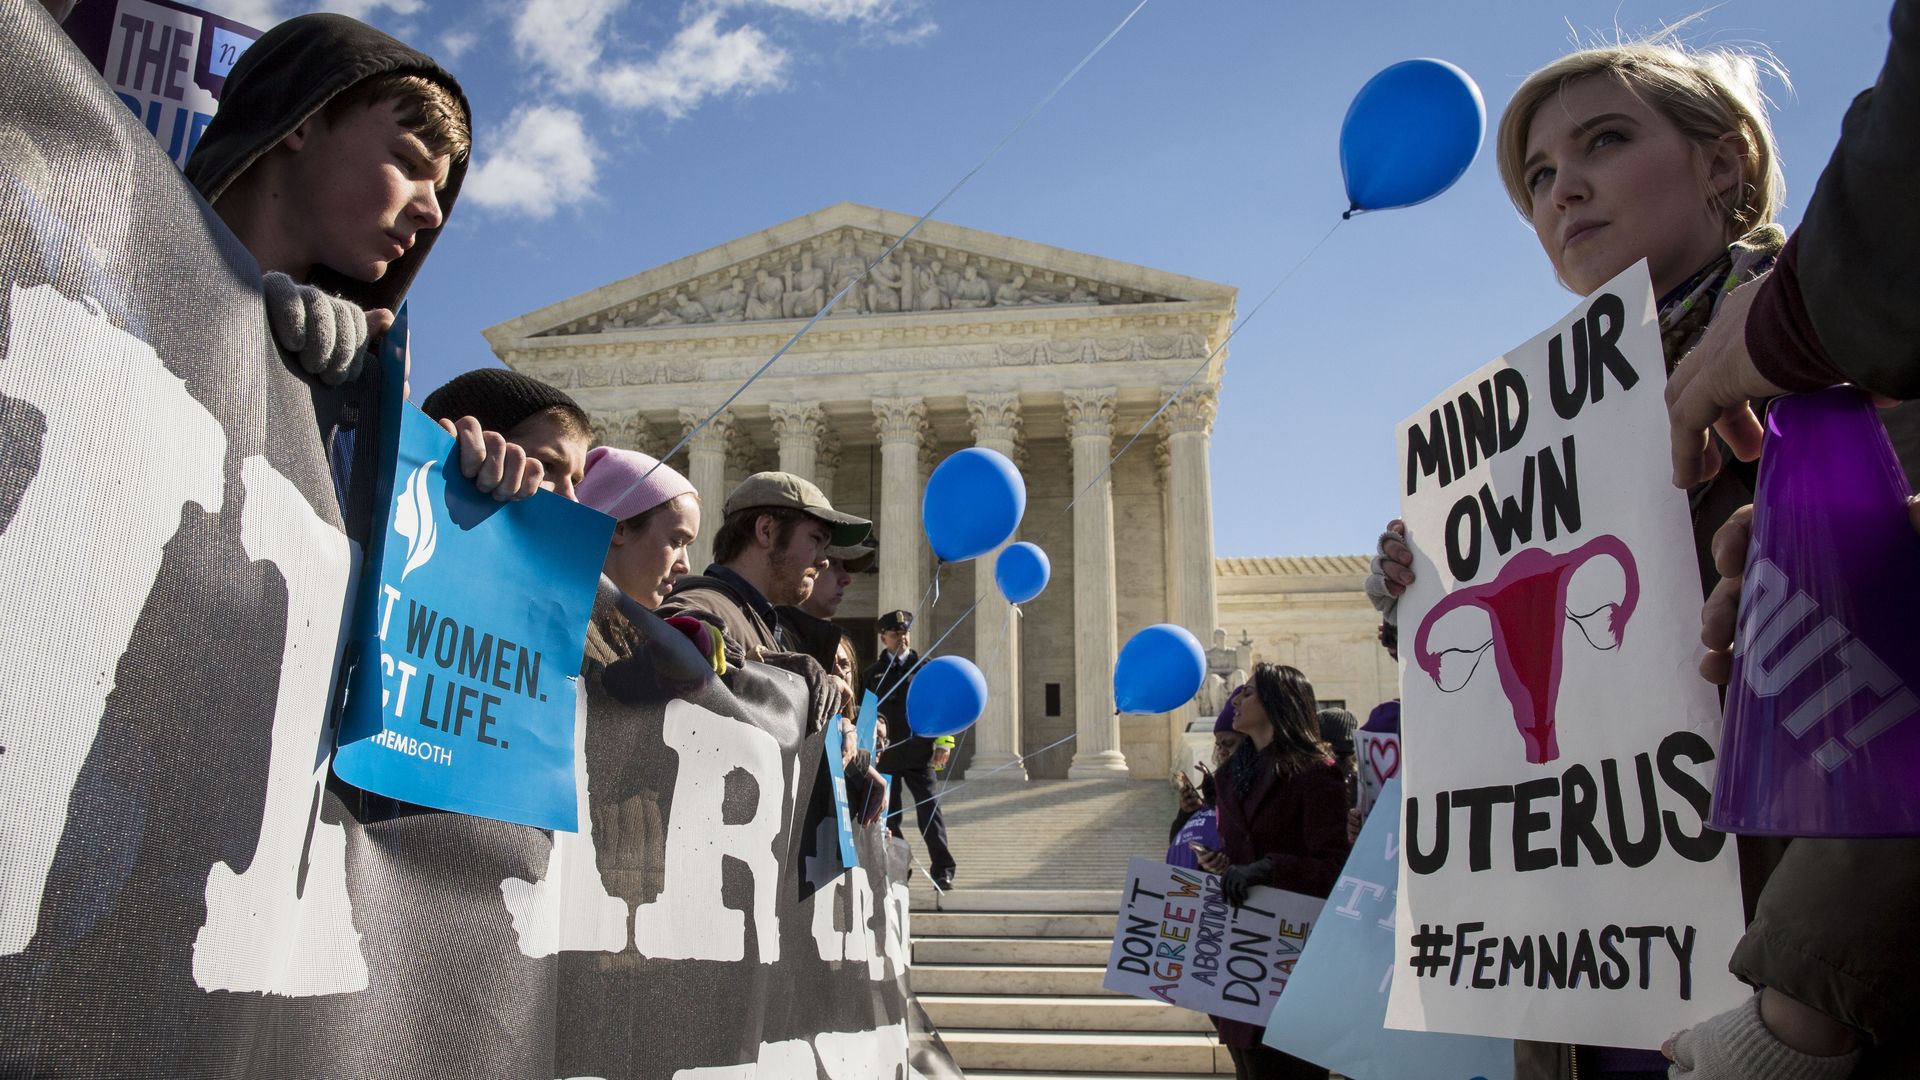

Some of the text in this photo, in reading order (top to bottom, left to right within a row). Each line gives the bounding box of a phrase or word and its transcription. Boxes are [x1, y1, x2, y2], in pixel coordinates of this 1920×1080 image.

[116, 12, 194, 101] THE
[1406, 292, 1640, 496] MIND UR
[1444, 434, 1582, 582] OWN
[405, 598, 548, 703] WOMEN.
[419, 673, 509, 749] LIFE.
[1405, 731, 1727, 875] UTERUS
[1117, 877, 1165, 976] DON'T
[1149, 902, 1197, 1005] AGREE
[1191, 875, 1229, 987] ABORTION?
[1222, 903, 1276, 1007] DON'T
